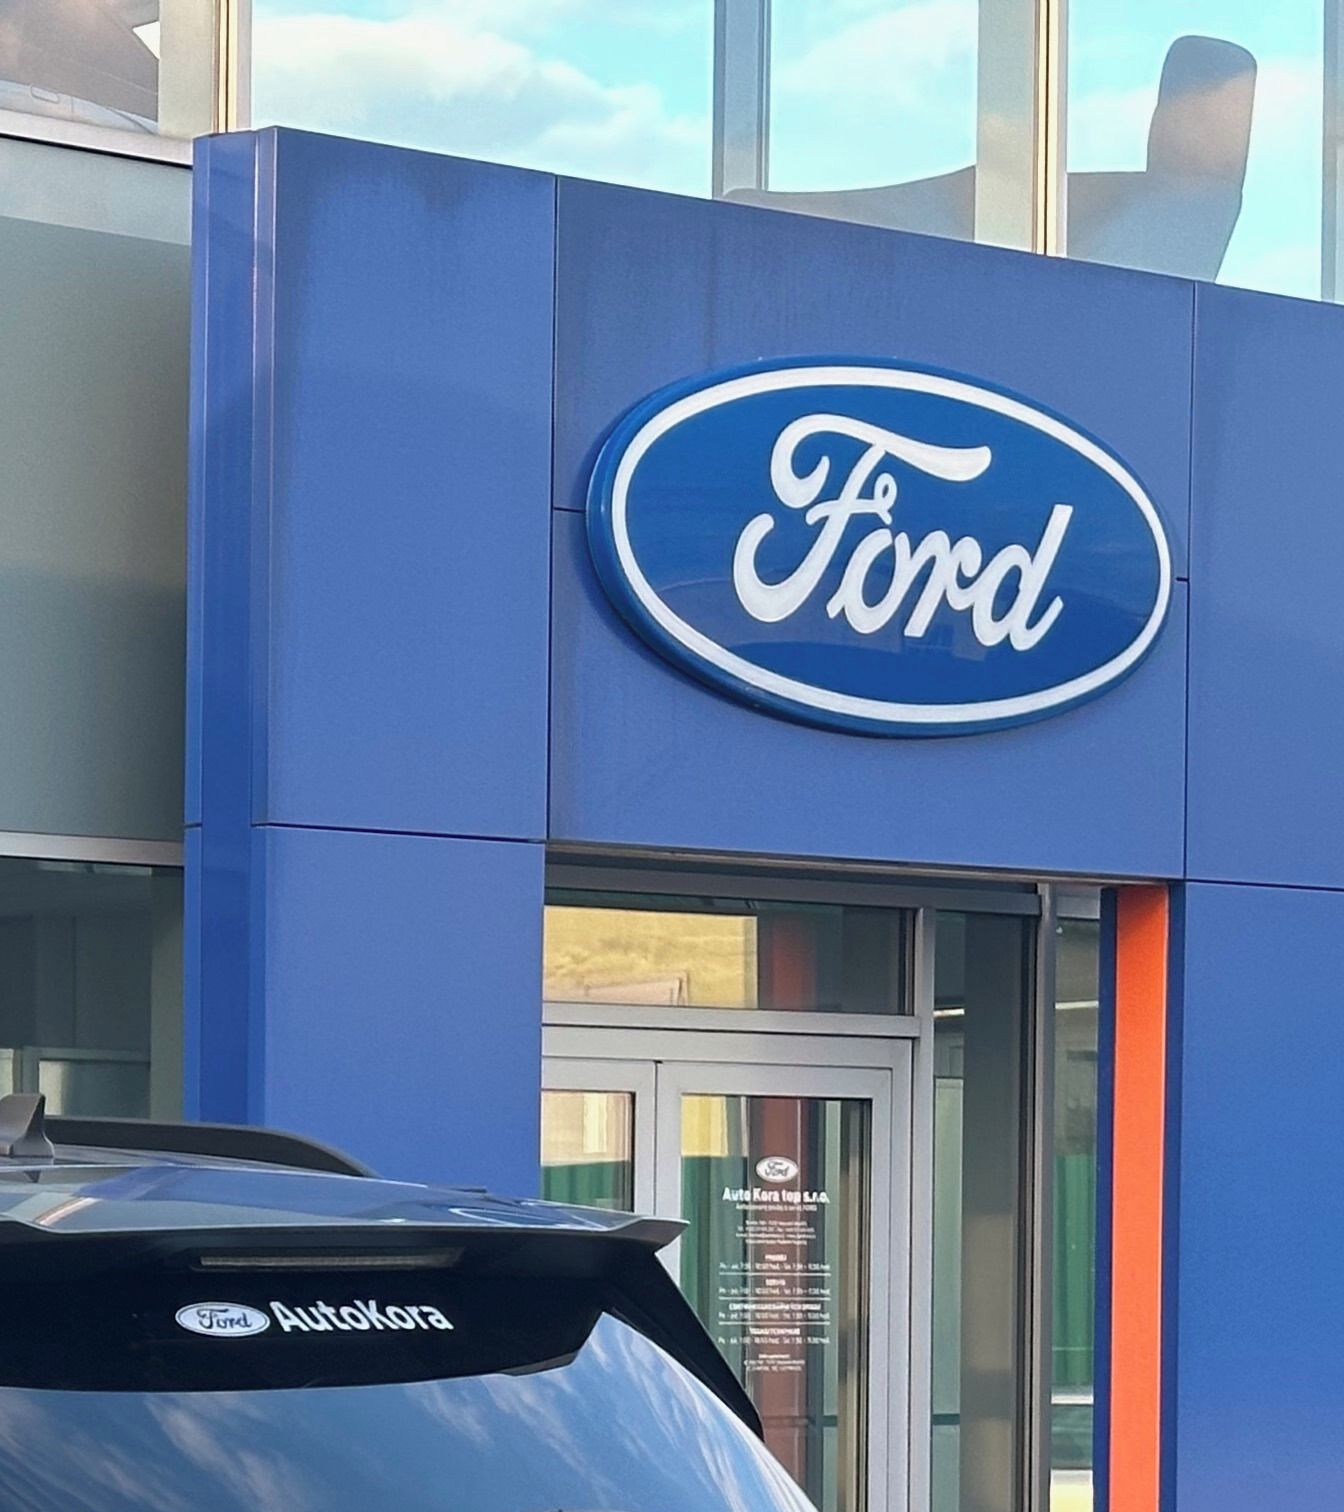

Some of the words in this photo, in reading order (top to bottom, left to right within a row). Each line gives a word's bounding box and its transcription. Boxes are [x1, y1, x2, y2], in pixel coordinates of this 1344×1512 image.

[733, 412, 1074, 652] Ford
[722, 1187, 752, 1203] Auto
[753, 1187, 780, 1203] Kora
